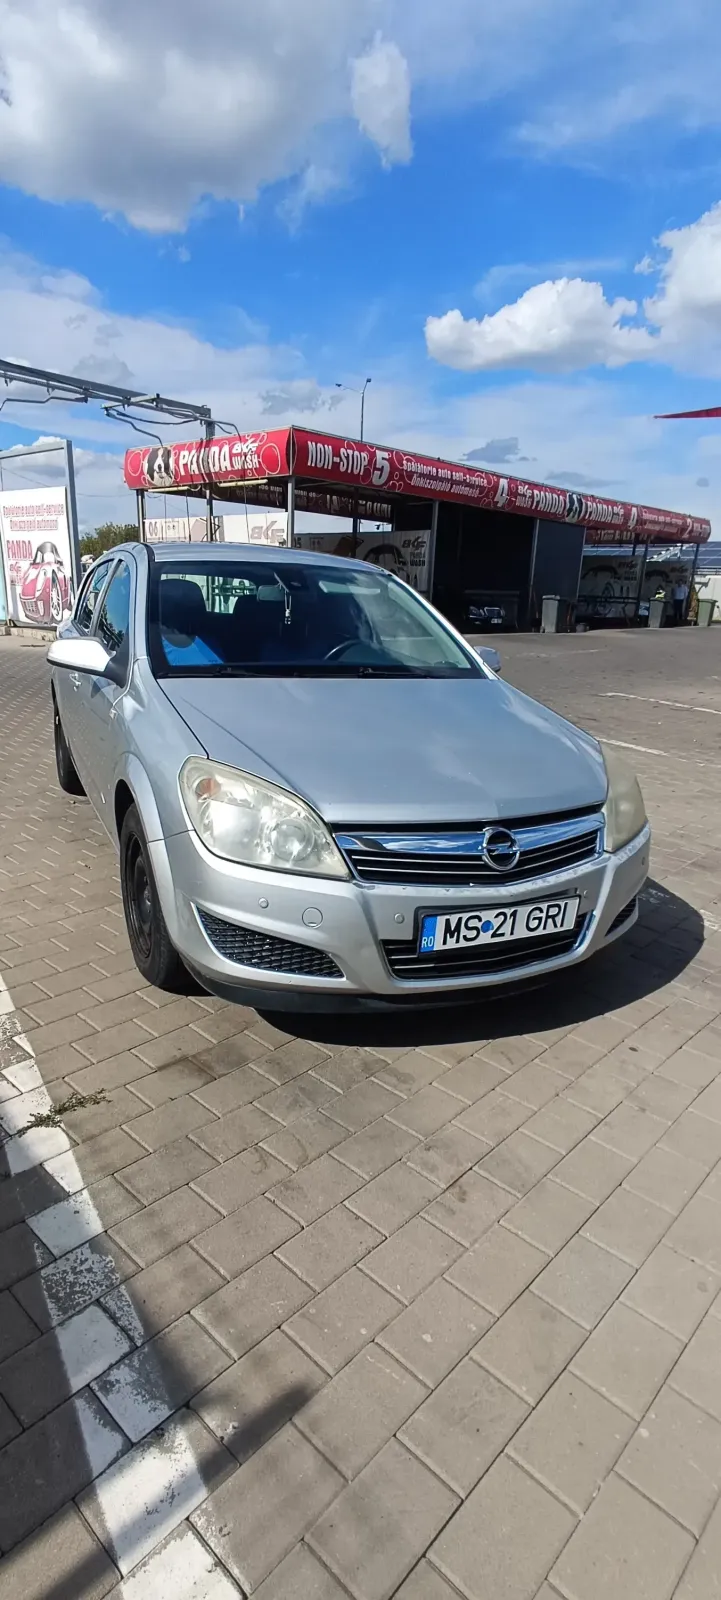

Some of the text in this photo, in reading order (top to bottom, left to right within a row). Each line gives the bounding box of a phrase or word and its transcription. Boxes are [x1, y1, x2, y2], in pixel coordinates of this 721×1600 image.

[232, 438, 259, 454] BKF
[180, 446, 231, 475] PANDA
[232, 454, 260, 470] WASH
[307, 441, 390, 485] NON-STOP 5
[438, 467, 451, 479] auto
[494, 478, 509, 507] 4
[532, 489, 565, 514] PANDA
[585, 501, 613, 523] PANDA
[148, 521, 159, 537] 06
[251, 520, 285, 543] BKF
[6, 540, 33, 560] PANDA
[442, 902, 568, 945] MS 21 GRI
[421, 936, 434, 948] RO
